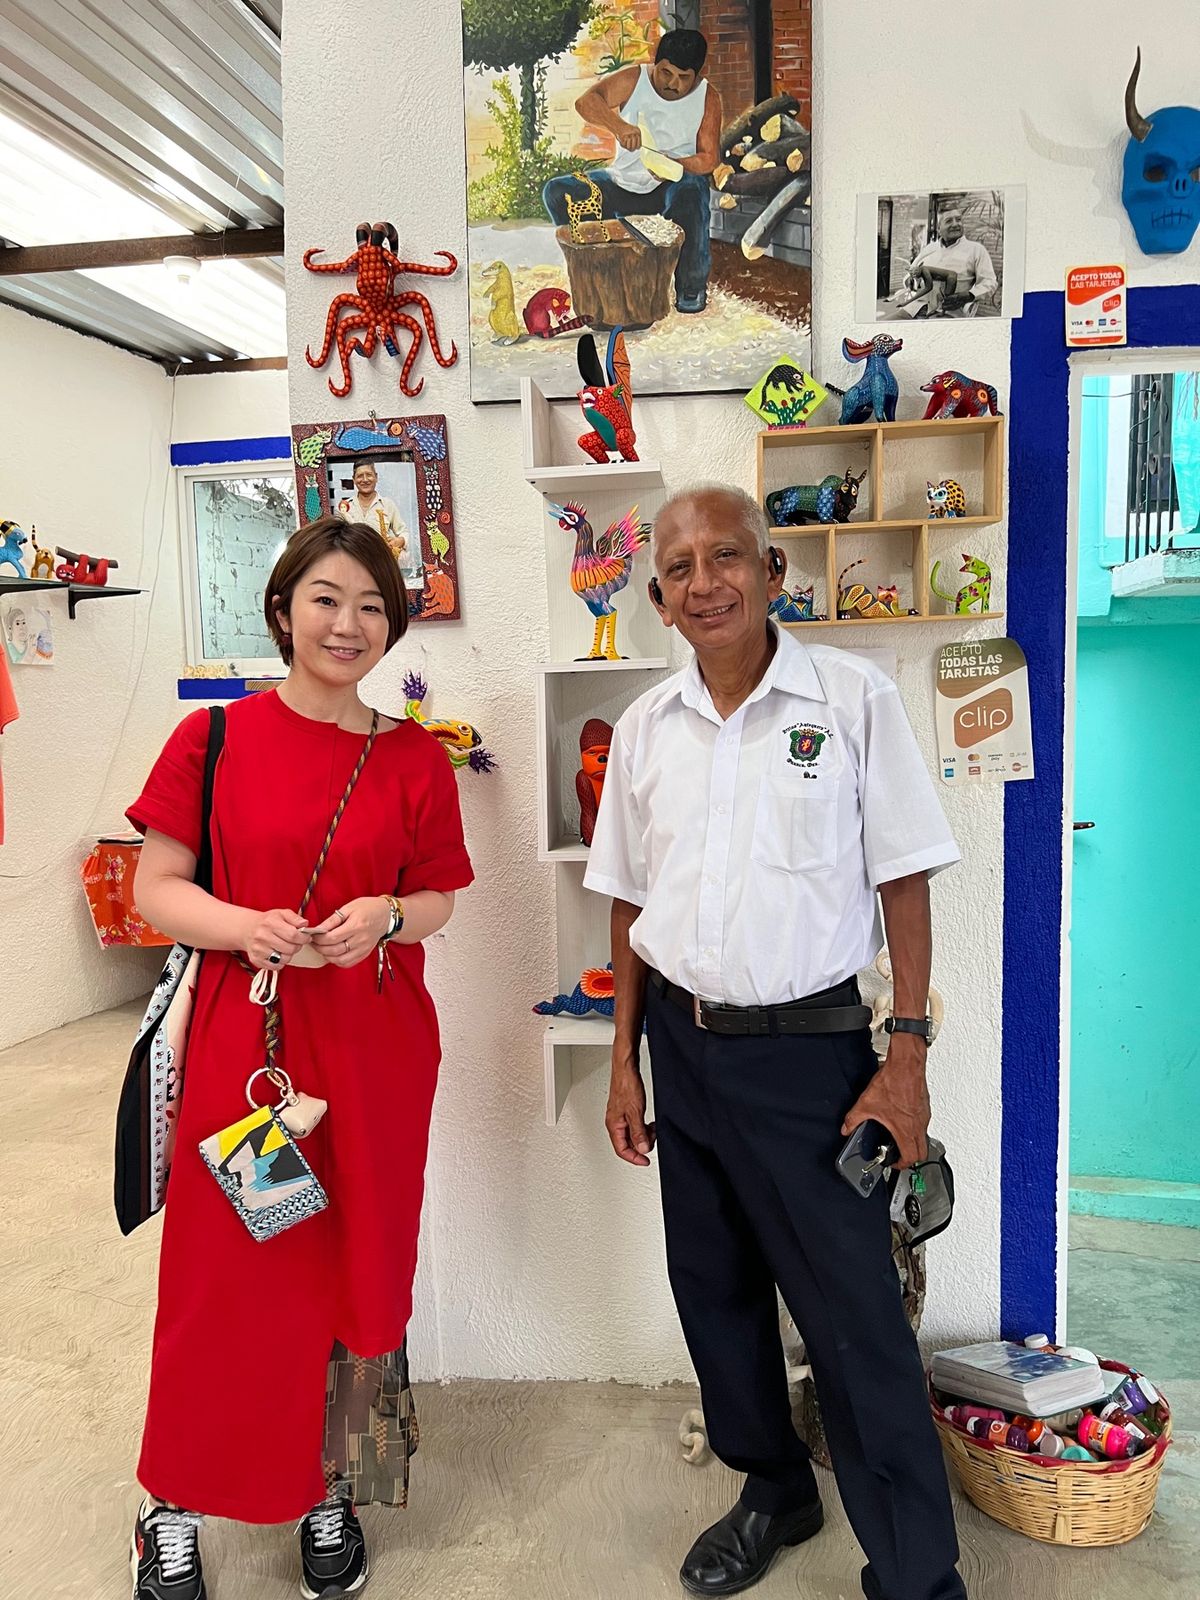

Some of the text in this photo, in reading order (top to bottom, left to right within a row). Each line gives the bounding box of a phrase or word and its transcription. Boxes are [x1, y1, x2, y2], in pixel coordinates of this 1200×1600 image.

[1070, 271, 1122, 281] ACEPTO TODAS
[1070, 279, 1120, 289] LAS TARJETAS
[1103, 299, 1120, 307] clip
[940, 644, 982, 658] ACEPTO
[940, 653, 1003, 669] TODAS LAS
[939, 665, 1000, 680] TARJETAS
[959, 705, 1007, 730] clip
